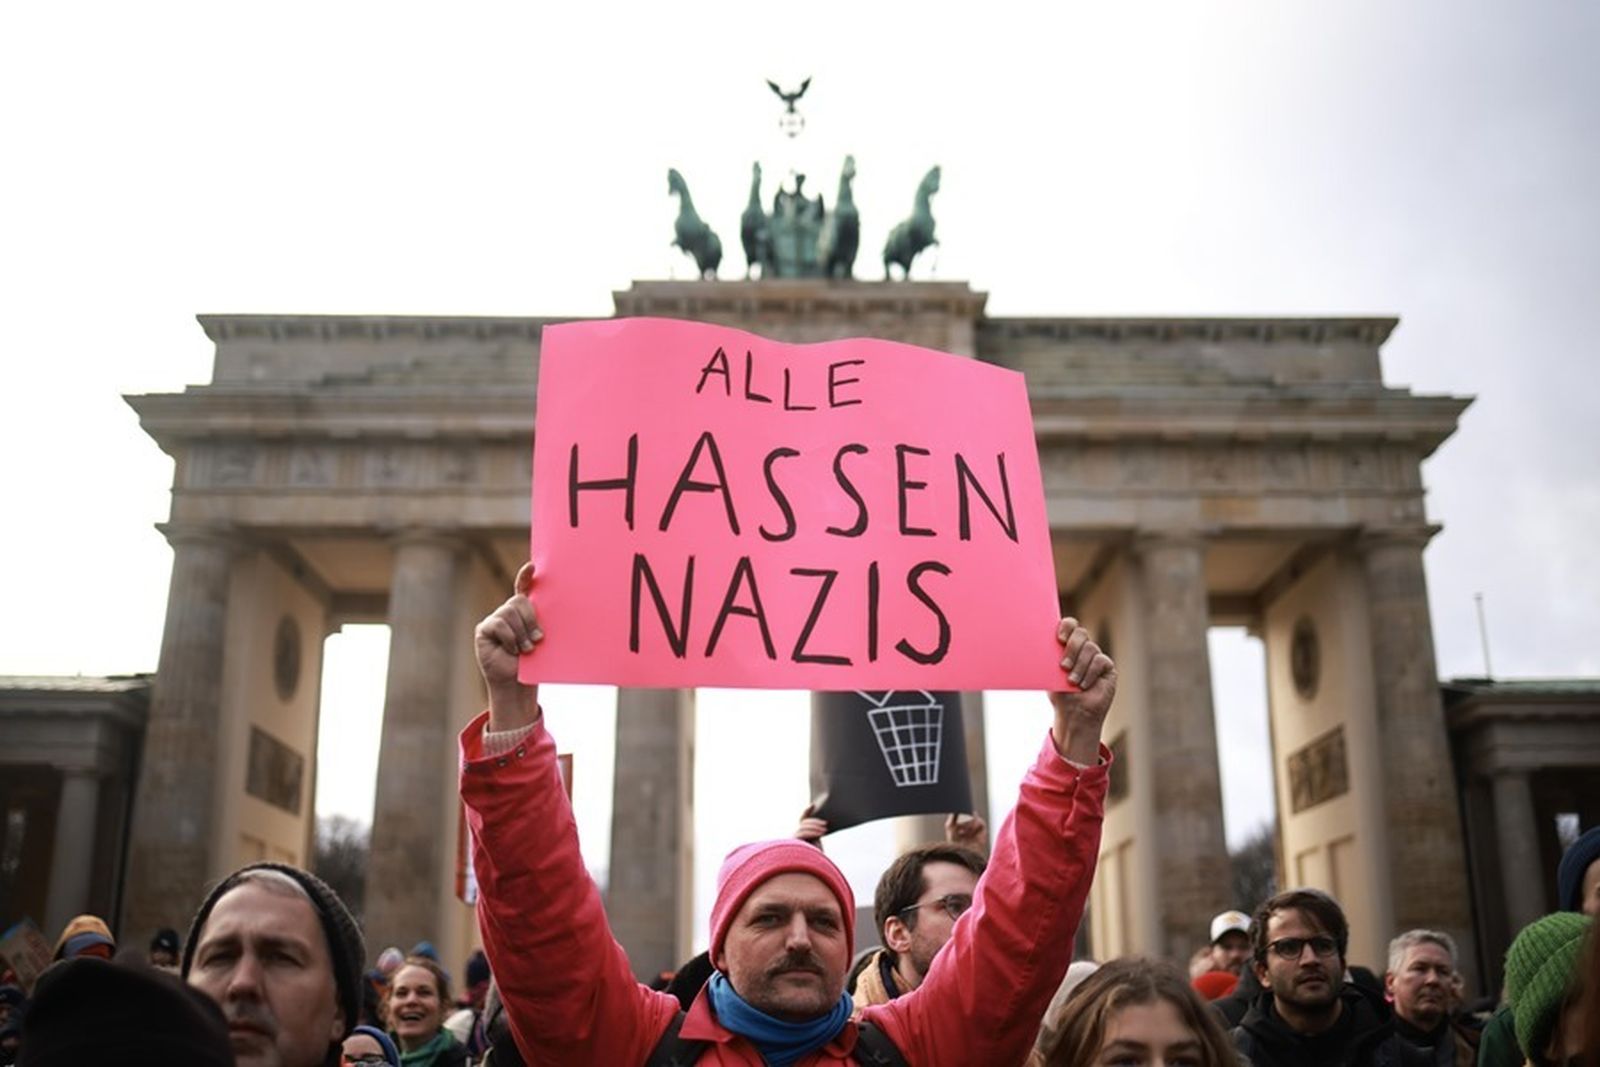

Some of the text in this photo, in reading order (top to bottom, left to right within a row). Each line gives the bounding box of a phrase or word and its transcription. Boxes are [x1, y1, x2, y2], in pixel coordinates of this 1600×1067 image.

[697, 346, 865, 411] ALLE
[568, 431, 1019, 543] HASSEN
[629, 553, 952, 665] NAZIS
